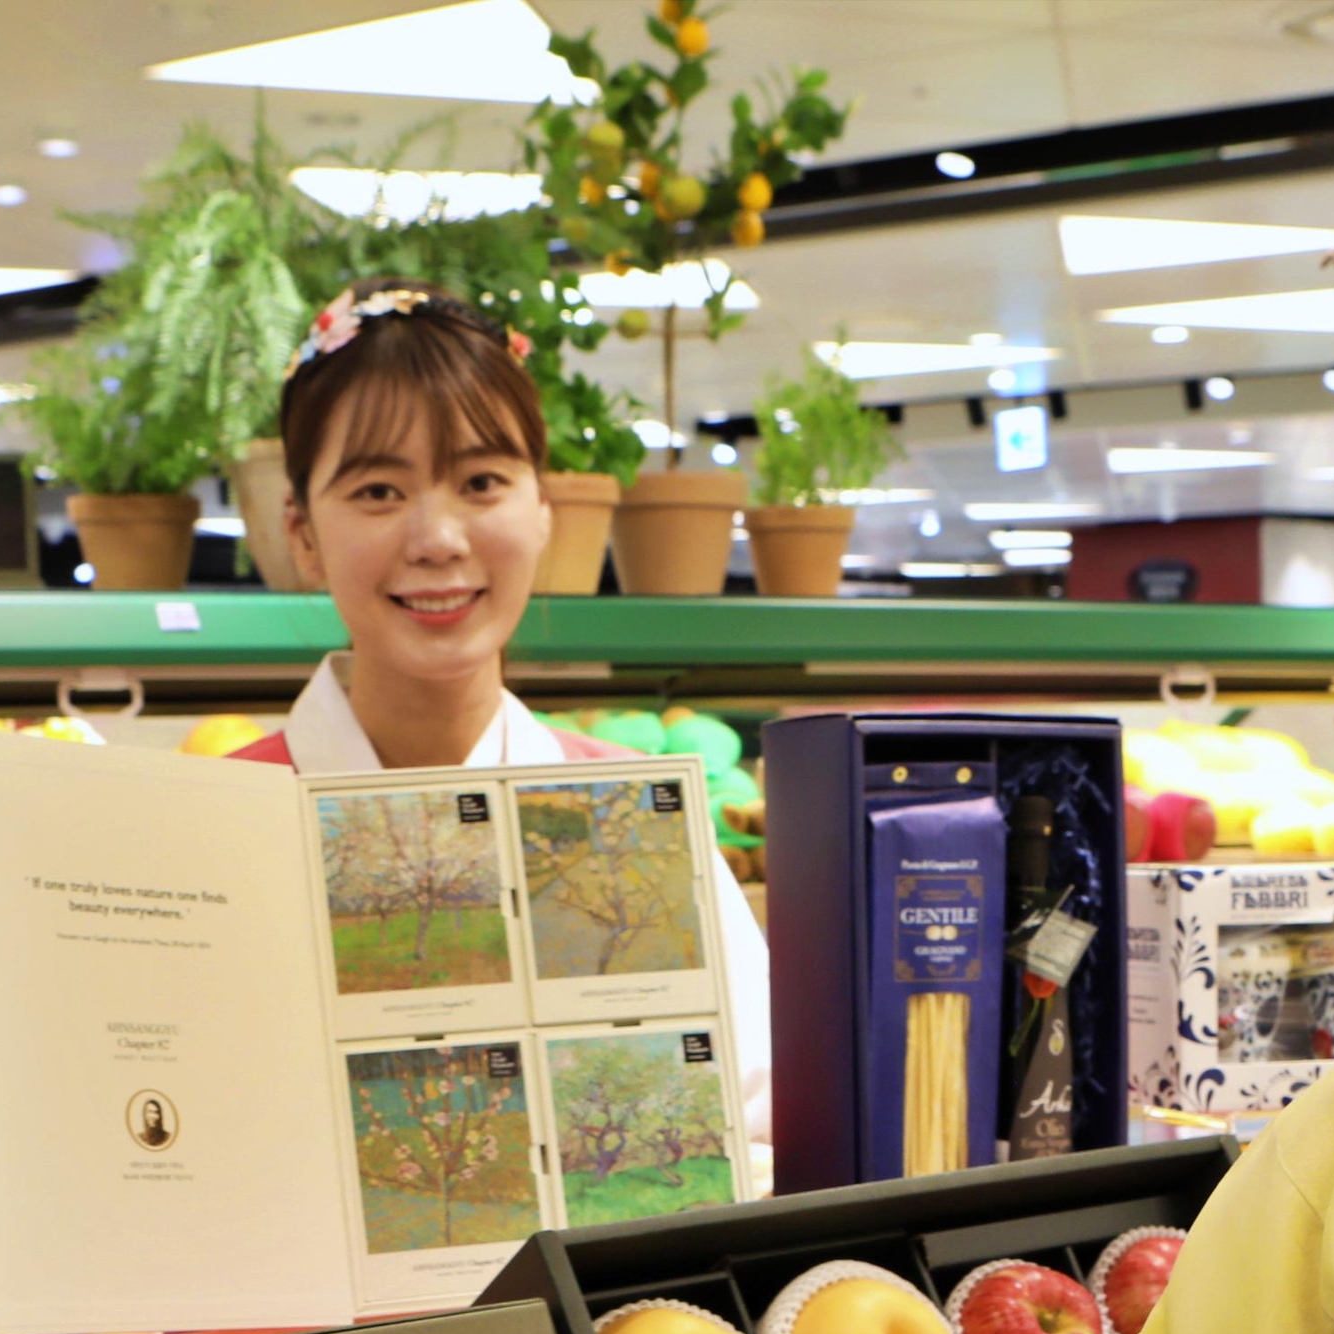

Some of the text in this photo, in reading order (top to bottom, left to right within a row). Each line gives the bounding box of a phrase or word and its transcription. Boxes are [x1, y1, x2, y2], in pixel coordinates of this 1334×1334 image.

[44, 880, 65, 891] one
[69, 881, 99, 896] truly
[102, 883, 132, 896] loves
[136, 887, 173, 900] nature
[176, 890, 198, 901] one
[69, 899, 109, 917] beauty
[1231, 891, 1309, 910] FABBRI
[899, 906, 978, 925] GENTILE
